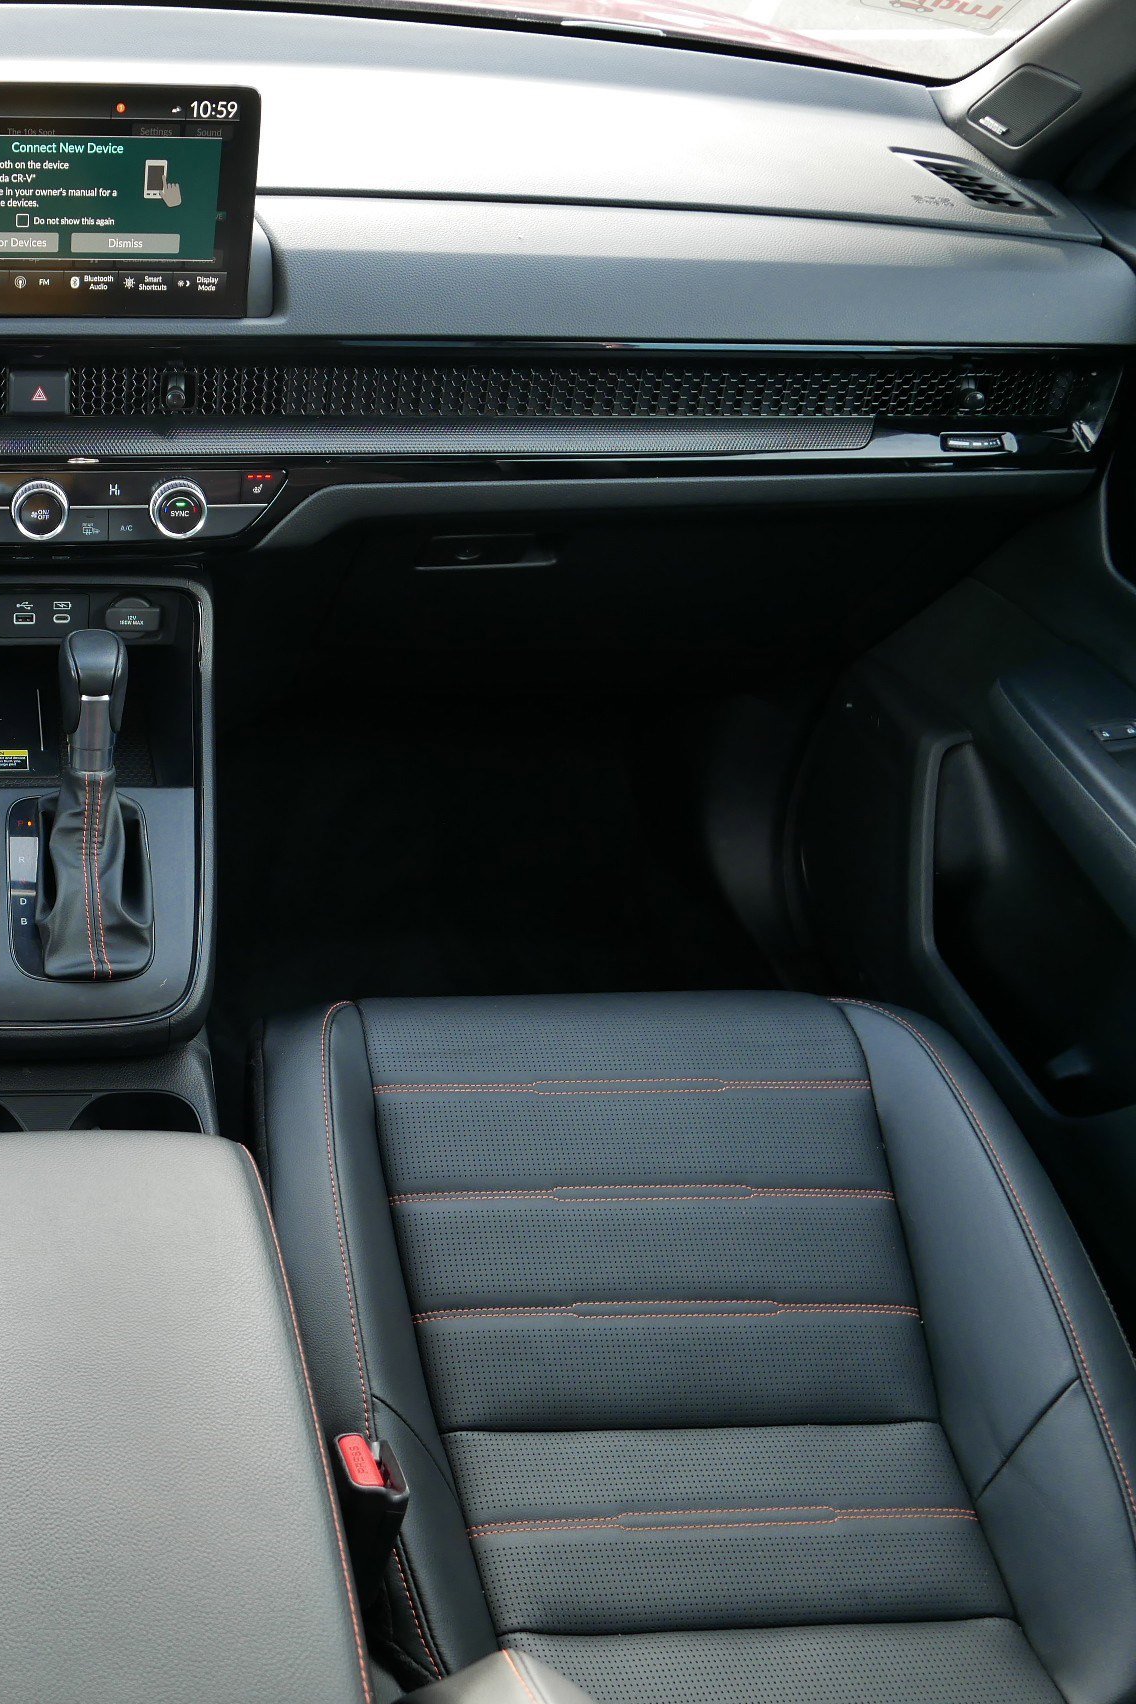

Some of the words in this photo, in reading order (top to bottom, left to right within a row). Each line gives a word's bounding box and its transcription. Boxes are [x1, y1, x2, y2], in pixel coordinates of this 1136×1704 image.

[190, 100, 238, 118] 10:59
[140, 127, 172, 137] Settings
[197, 128, 222, 137] Sound
[11, 142, 57, 153] Connect
[59, 142, 85, 154] New
[87, 142, 124, 154] Device
[14, 161, 26, 169] on
[27, 160, 41, 169] the
[43, 160, 70, 170] device
[5, 187, 13, 196] in
[15, 188, 33, 197] your
[35, 188, 66, 196] owner's
[68, 188, 97, 197] manual
[99, 188, 110, 197] for
[112, 189, 118, 197] a
[7, 198, 39, 208] devices.
[33, 216, 45, 225] Do
[46, 217, 59, 225] not
[61, 216, 80, 225] show
[81, 217, 95, 225] this
[96, 217, 115, 227] again
[10, 237, 47, 248] Devices
[108, 238, 143, 248] Dismiss
[38, 278, 50, 286] FM
[144, 275, 163, 283] Smart
[196, 276, 219, 284] Display
[89, 283, 108, 291] Audio
[138, 283, 167, 291] Shortcuts
[119, 524, 133, 532] A/C
[19, 897, 27, 906] D
[20, 917, 28, 926] B
